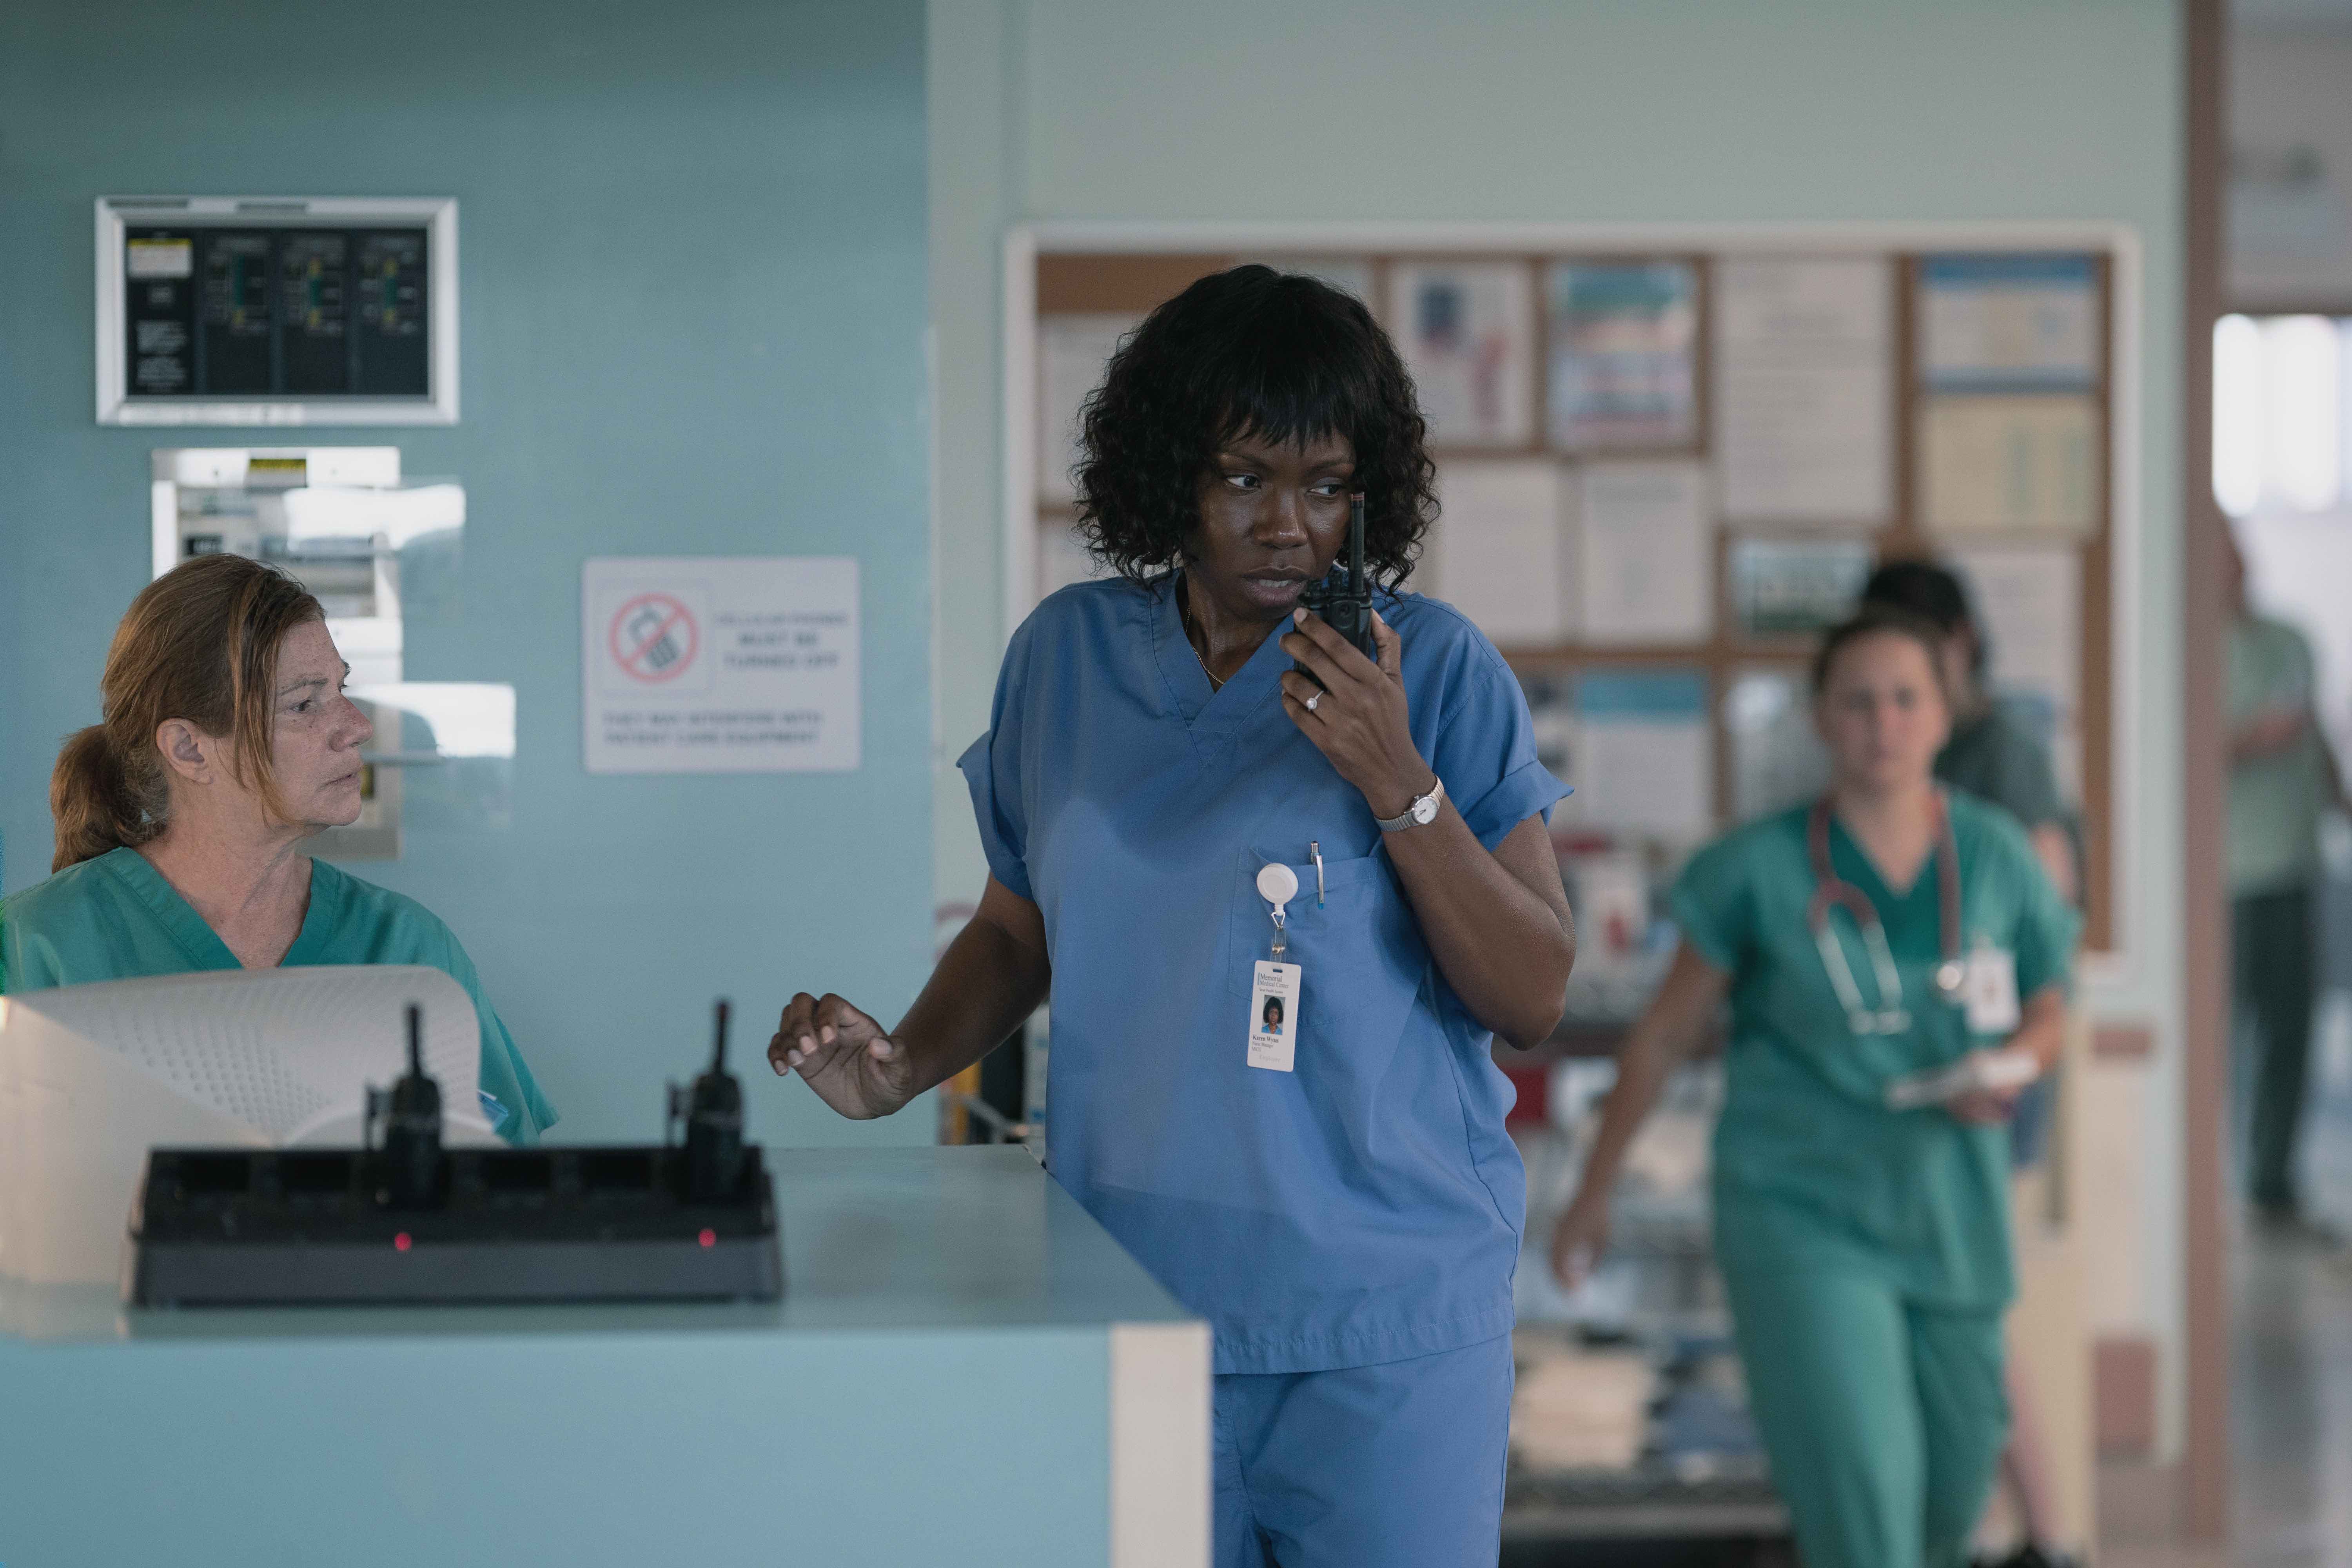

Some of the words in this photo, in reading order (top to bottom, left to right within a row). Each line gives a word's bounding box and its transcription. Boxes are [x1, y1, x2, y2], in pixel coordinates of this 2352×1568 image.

[739, 632, 788, 646] MUST
[793, 632, 818, 646] BE
[725, 652, 798, 669] TURNED
[803, 652, 838, 668] OFF
[604, 711, 644, 726] THEY
[649, 711, 681, 726] MAY
[688, 711, 773, 726] INTERFERE
[781, 711, 822, 726] WITH
[605, 730, 671, 745] PATIENT
[675, 730, 718, 745] CARE
[725, 730, 818, 745] EQUIPMENT
[1260, 973, 1283, 982] Memorial
